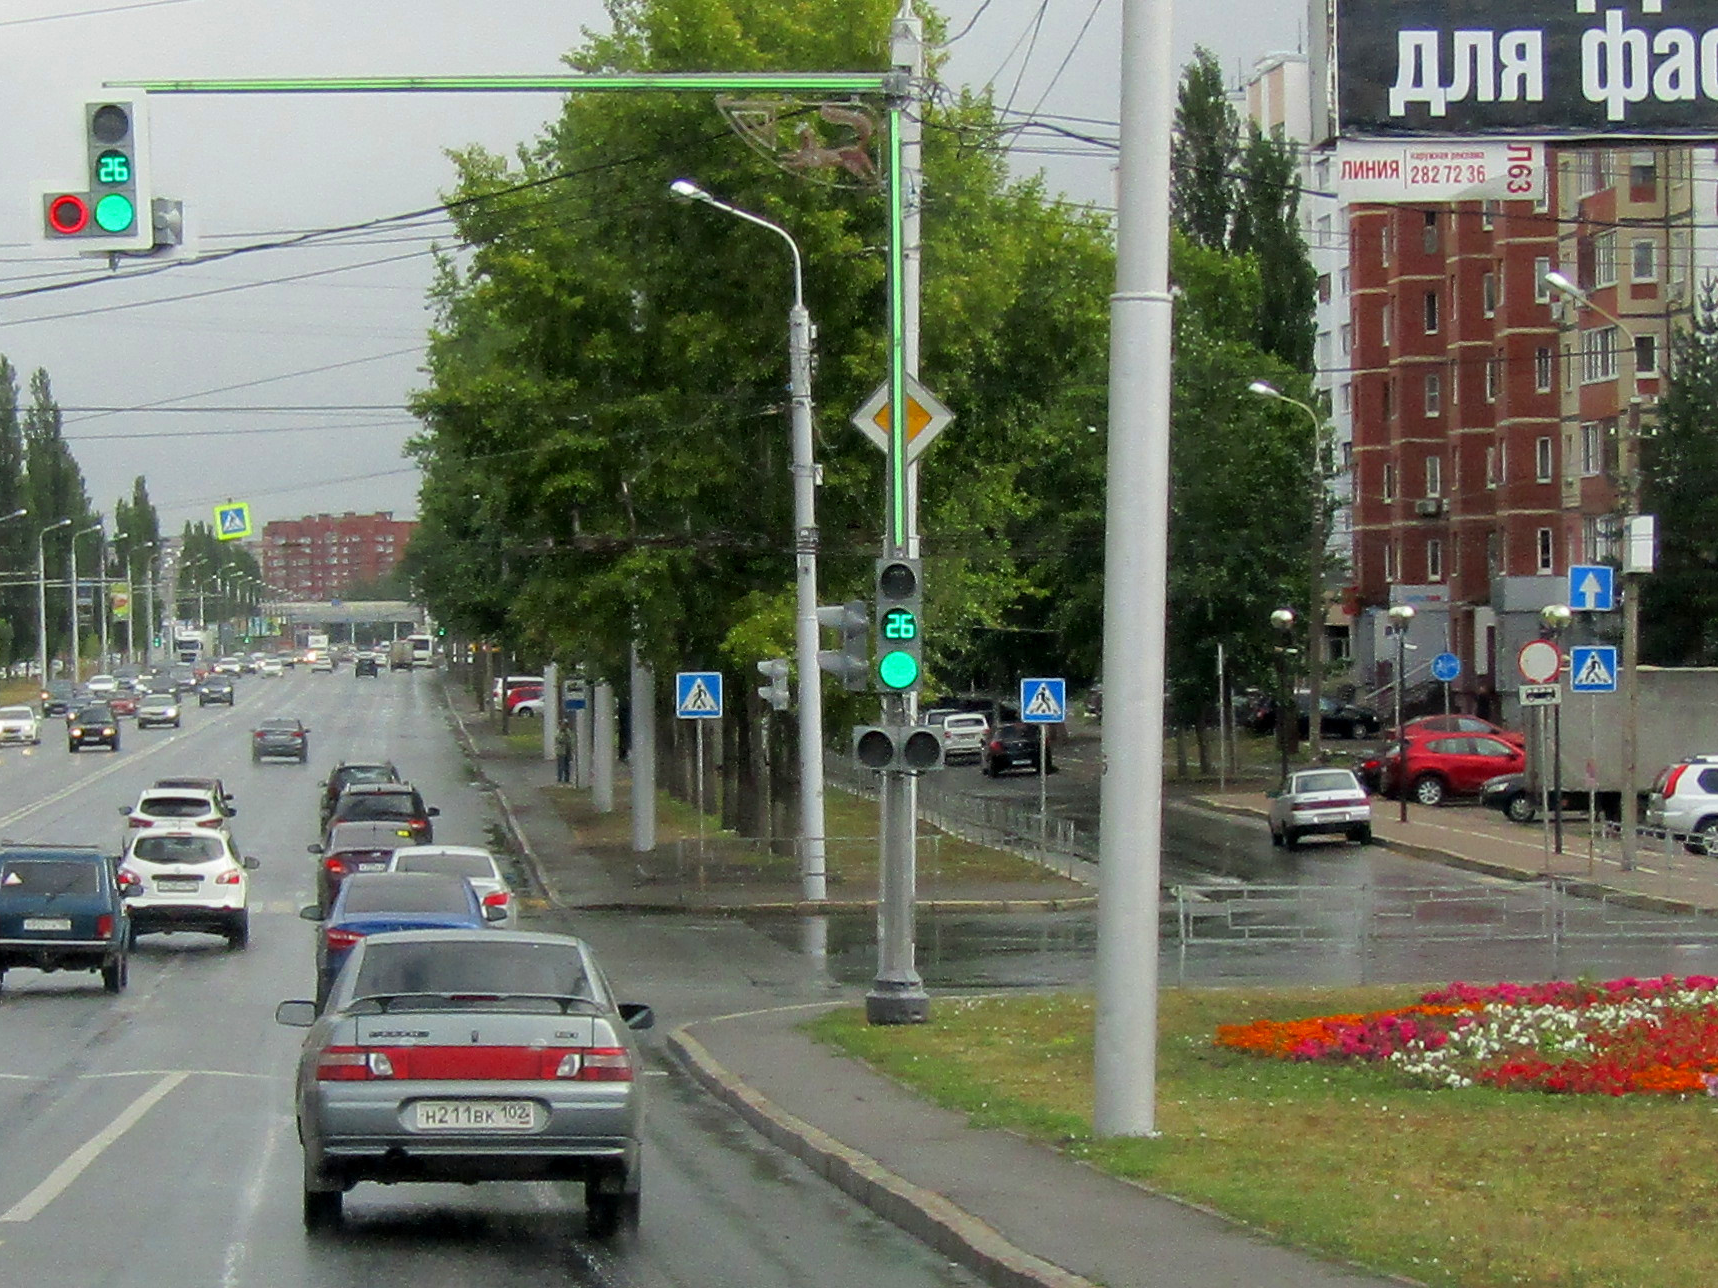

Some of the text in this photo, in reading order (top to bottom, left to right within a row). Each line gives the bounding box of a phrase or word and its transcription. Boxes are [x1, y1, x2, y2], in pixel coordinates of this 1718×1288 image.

[1389, 28, 1544, 117] для
[99, 157, 129, 184] 26
[1341, 159, 1400, 180] ЛИНИЯ
[1410, 164, 1486, 184] 282 72 36
[1506, 143, 1532, 194] Л63
[885, 613, 915, 639] 26
